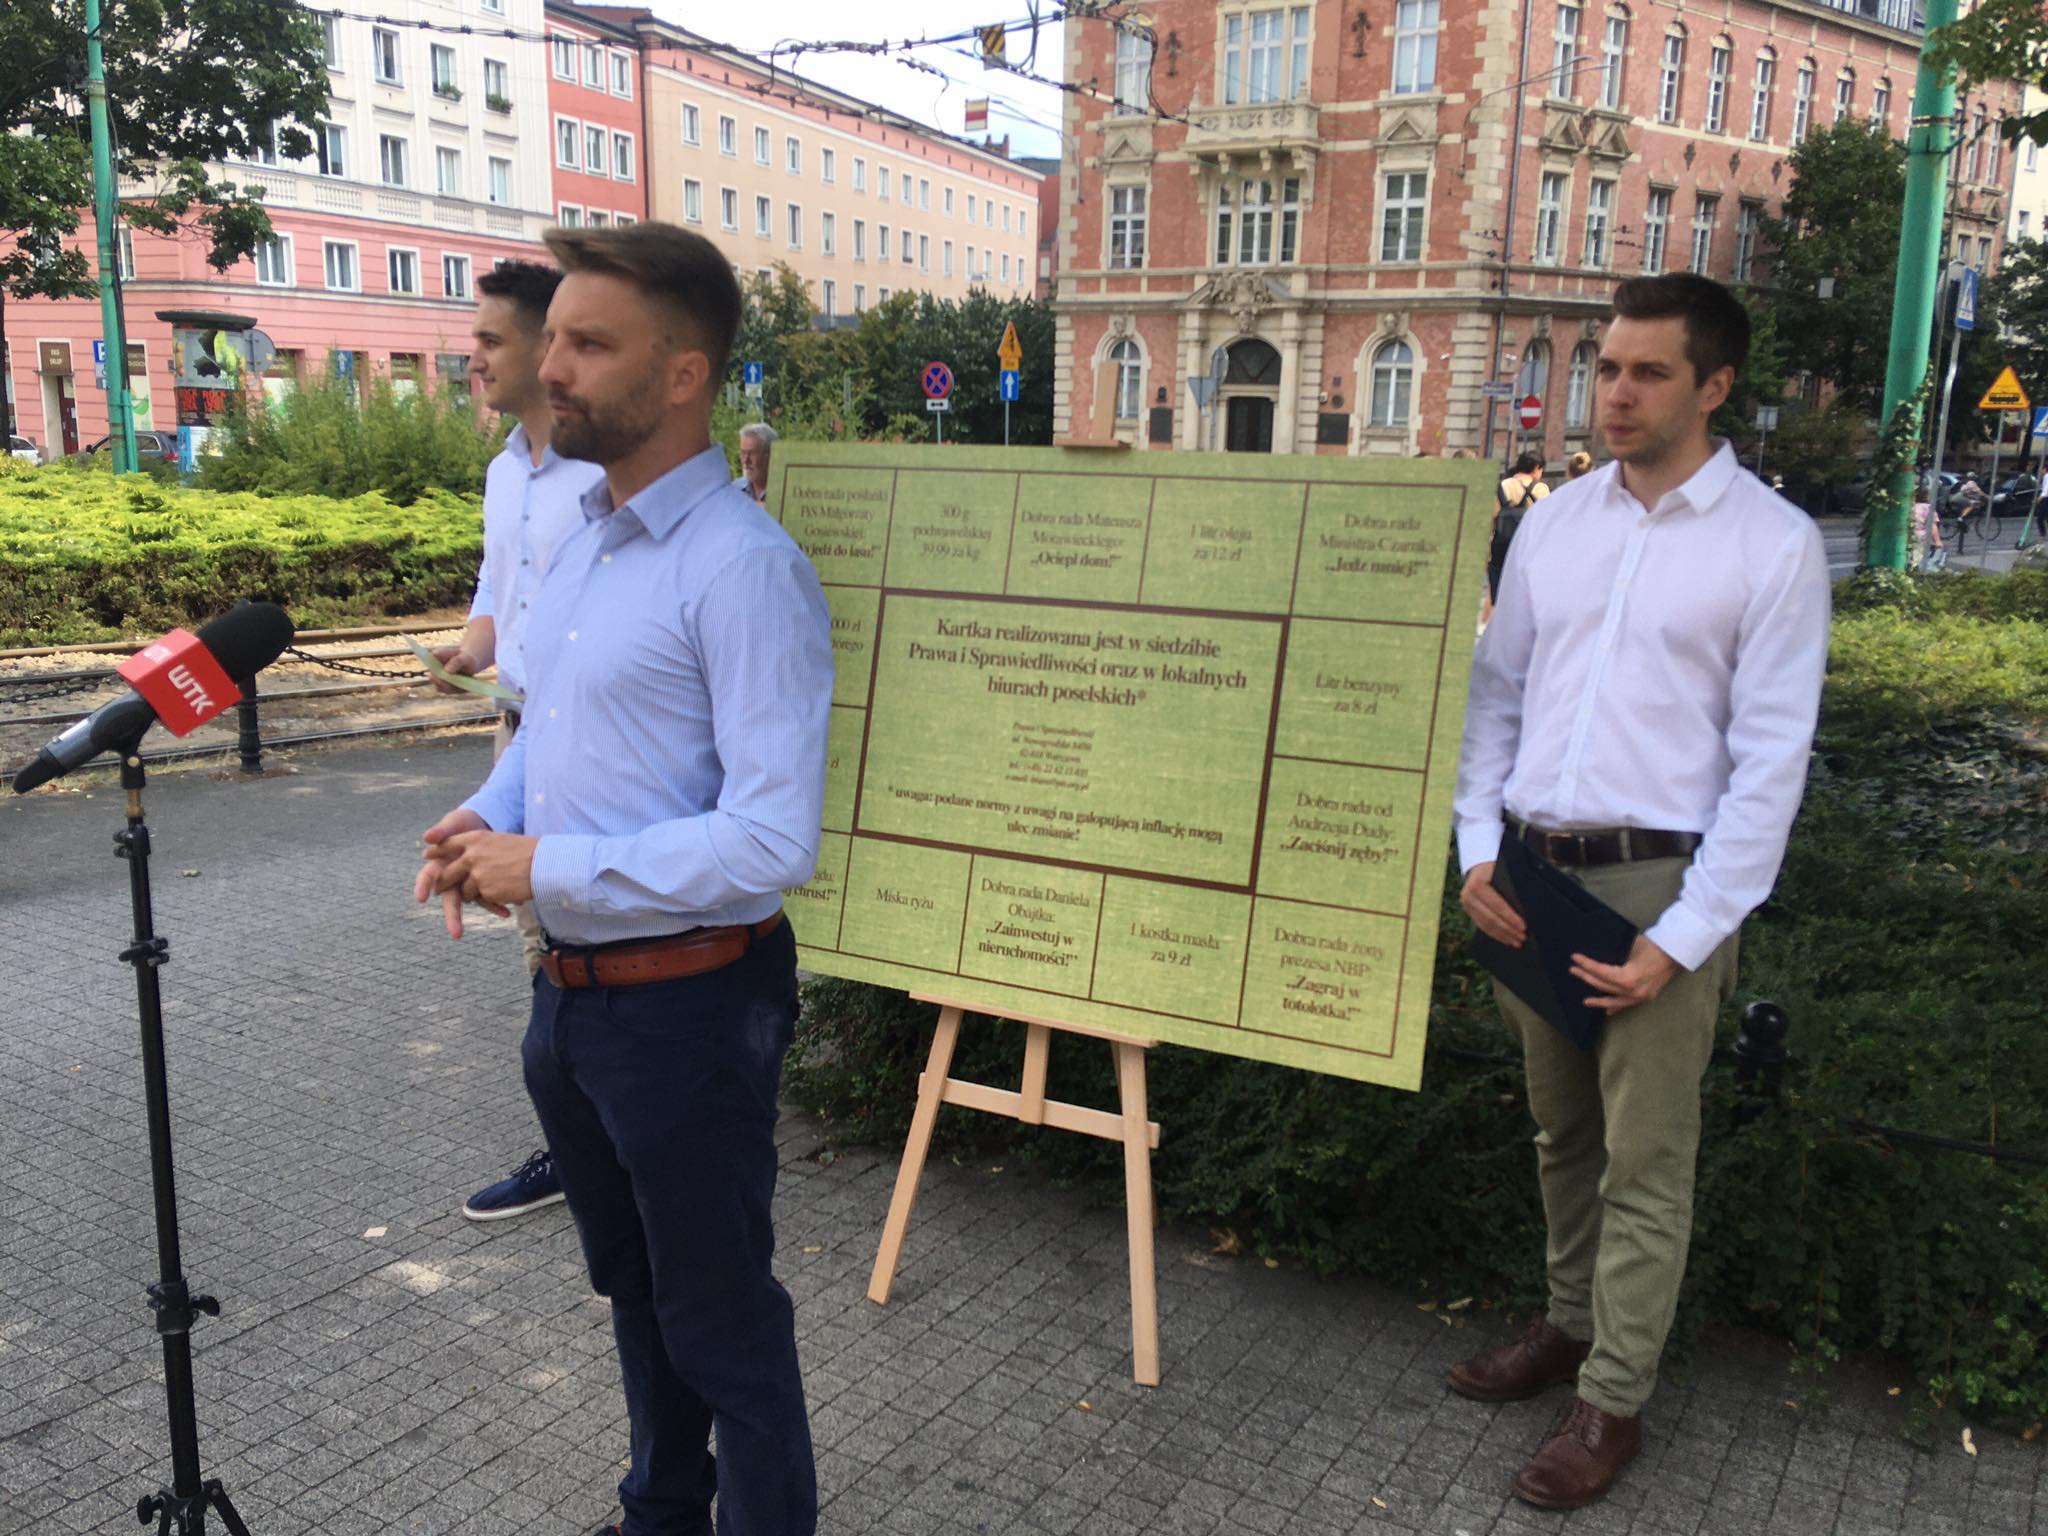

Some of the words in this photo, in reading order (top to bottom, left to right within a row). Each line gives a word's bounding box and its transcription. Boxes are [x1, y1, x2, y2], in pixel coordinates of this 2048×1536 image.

[1021, 511, 1056, 525] Dobra
[1344, 513, 1387, 529] Dobra
[1390, 514, 1421, 531] rada
[834, 544, 848, 557] do
[936, 618, 992, 639] Kartka
[995, 624, 1091, 647] realizowana
[1091, 630, 1124, 652] jest
[1129, 637, 1143, 651] w
[1146, 635, 1222, 658] siedzibie
[909, 642, 957, 662] Prawa
[960, 646, 966, 664] i
[968, 646, 1098, 675] Sprawiedliwości
[1100, 662, 1138, 679] oraz
[1143, 666, 1157, 681] w
[1161, 664, 1248, 691] lokalnych
[987, 675, 1049, 698] biurach
[1296, 791, 1340, 810] Dobra
[1341, 800, 1371, 815] rada
[1373, 802, 1393, 818] od
[895, 789, 933, 803] uwaga:
[934, 793, 974, 807] podane
[975, 799, 1010, 815] normy
[1013, 804, 1021, 814] z
[1022, 806, 1057, 821] uwagi
[1058, 810, 1075, 821] na
[1075, 811, 1140, 833] galopującą
[1141, 818, 1186, 839] inflację
[1188, 828, 1224, 845] mogą
[1006, 820, 1030, 834] ulec
[1287, 815, 1350, 837] Andrzeja
[876, 888, 908, 905] Miska
[910, 895, 935, 911] ryżu
[981, 877, 1016, 896] Dobra
[1018, 885, 1043, 900] rada
[1045, 888, 1090, 908] Daniela
[1063, 935, 1074, 946] w
[1140, 923, 1180, 943] kostka
[1182, 933, 1220, 950] masła
[1274, 927, 1317, 946] Dobra
[1318, 936, 1348, 952] rada
[1151, 950, 1166, 962] za
[1167, 949, 1178, 964] 9
[1179, 952, 1192, 967] zł
[1280, 954, 1331, 971] prezesa
[1348, 986, 1360, 999] w
